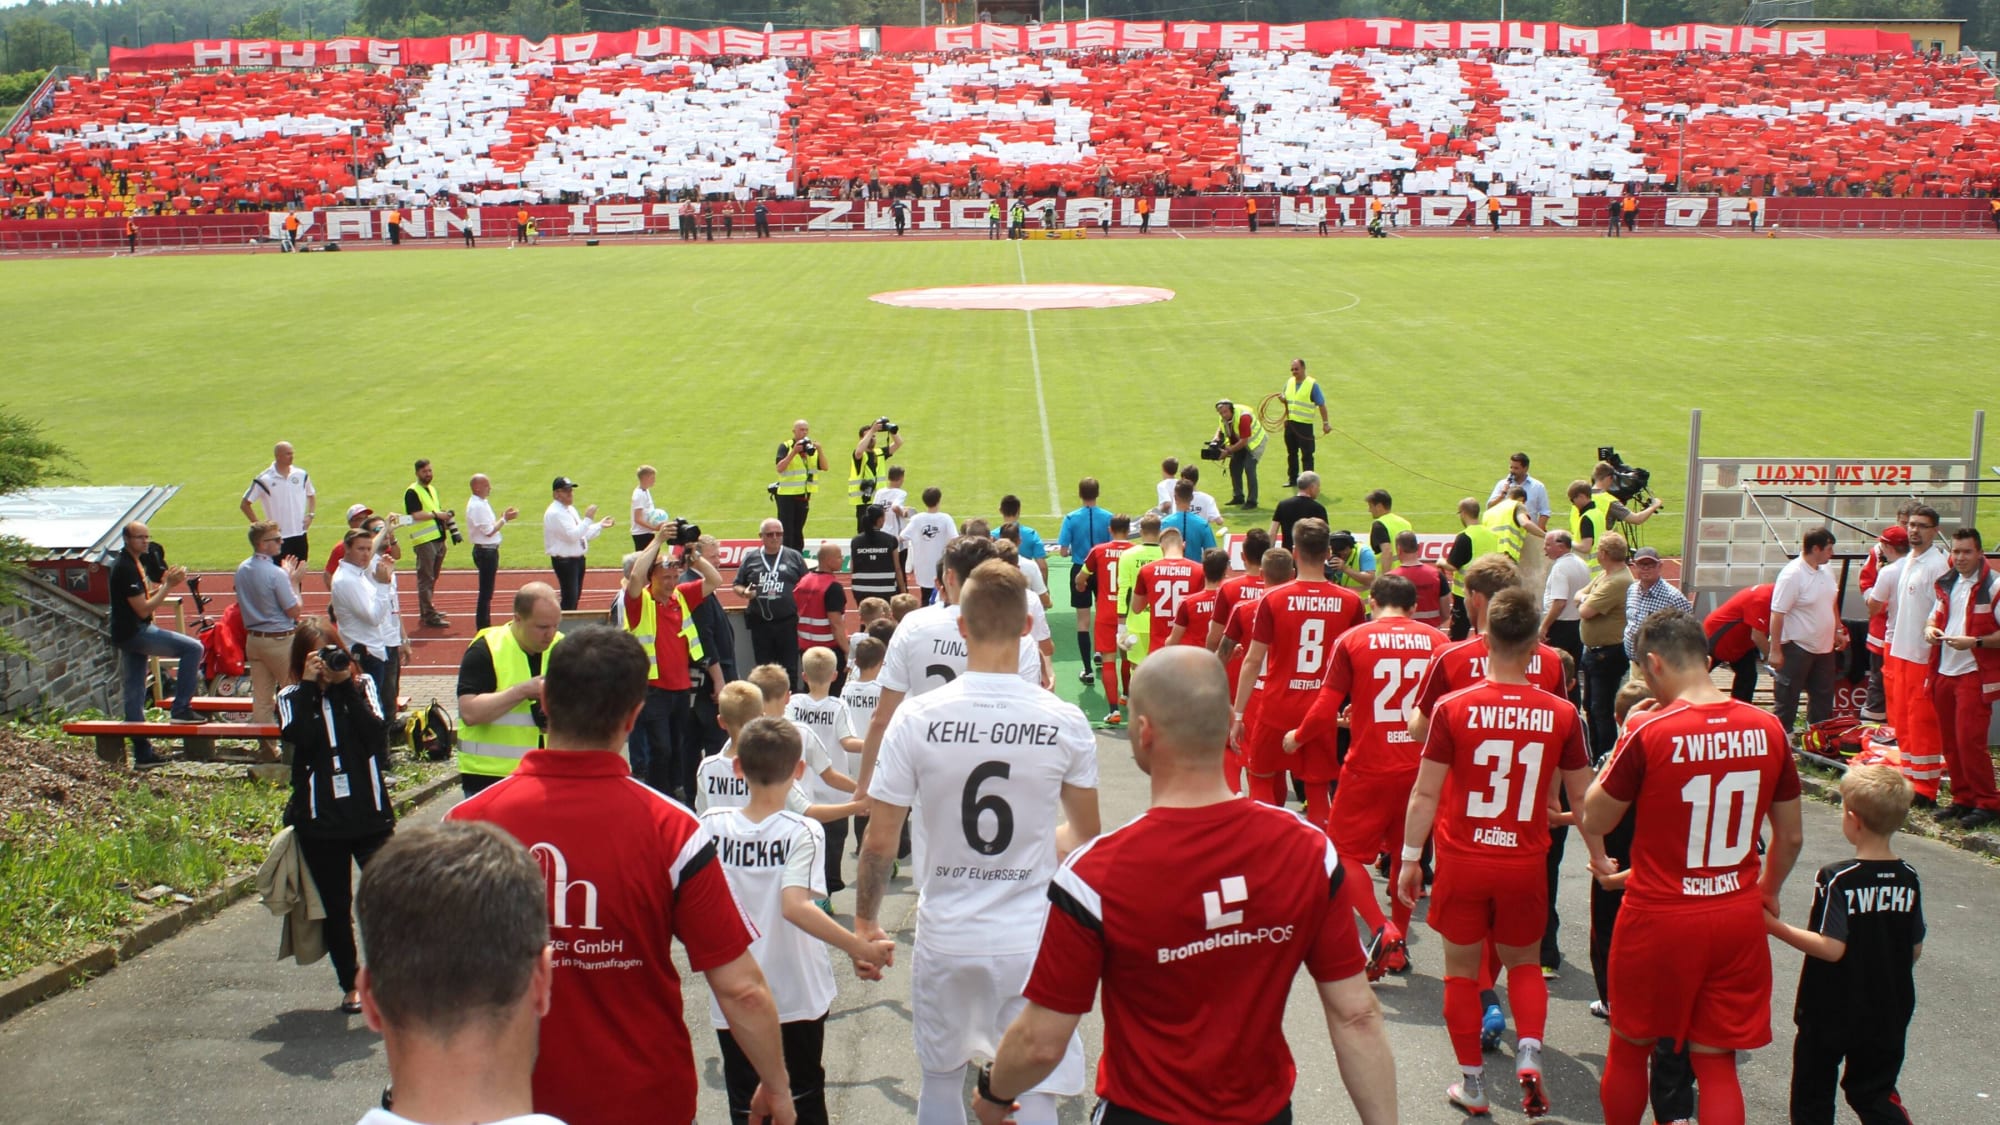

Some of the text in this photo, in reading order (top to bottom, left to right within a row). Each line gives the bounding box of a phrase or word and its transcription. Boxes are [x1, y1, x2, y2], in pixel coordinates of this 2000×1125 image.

[193, 39, 399, 66] HEUTE
[636, 26, 860, 56] UNSER
[1366, 19, 1598, 53] TRAUM
[1651, 25, 1826, 55] WAHR
[568, 203, 701, 233] IST
[1155, 580, 1189, 617] 26
[1297, 618, 1325, 673] 8
[1373, 658, 1431, 723] 22
[926, 721, 1060, 746] KEHL-GOMEZ
[1466, 739, 1545, 822] 31
[961, 760, 1014, 856] 6
[1681, 769, 1761, 869] 10
[1473, 826, 1518, 847] P.GÖBEL
[936, 866, 950, 877] SV
[952, 867, 966, 878] 07
[573, 939, 623, 954] GmbH
[1157, 924, 1294, 963] Bromelain-POS
[561, 957, 571, 966] in
[573, 958, 643, 970] Pharmafragen
